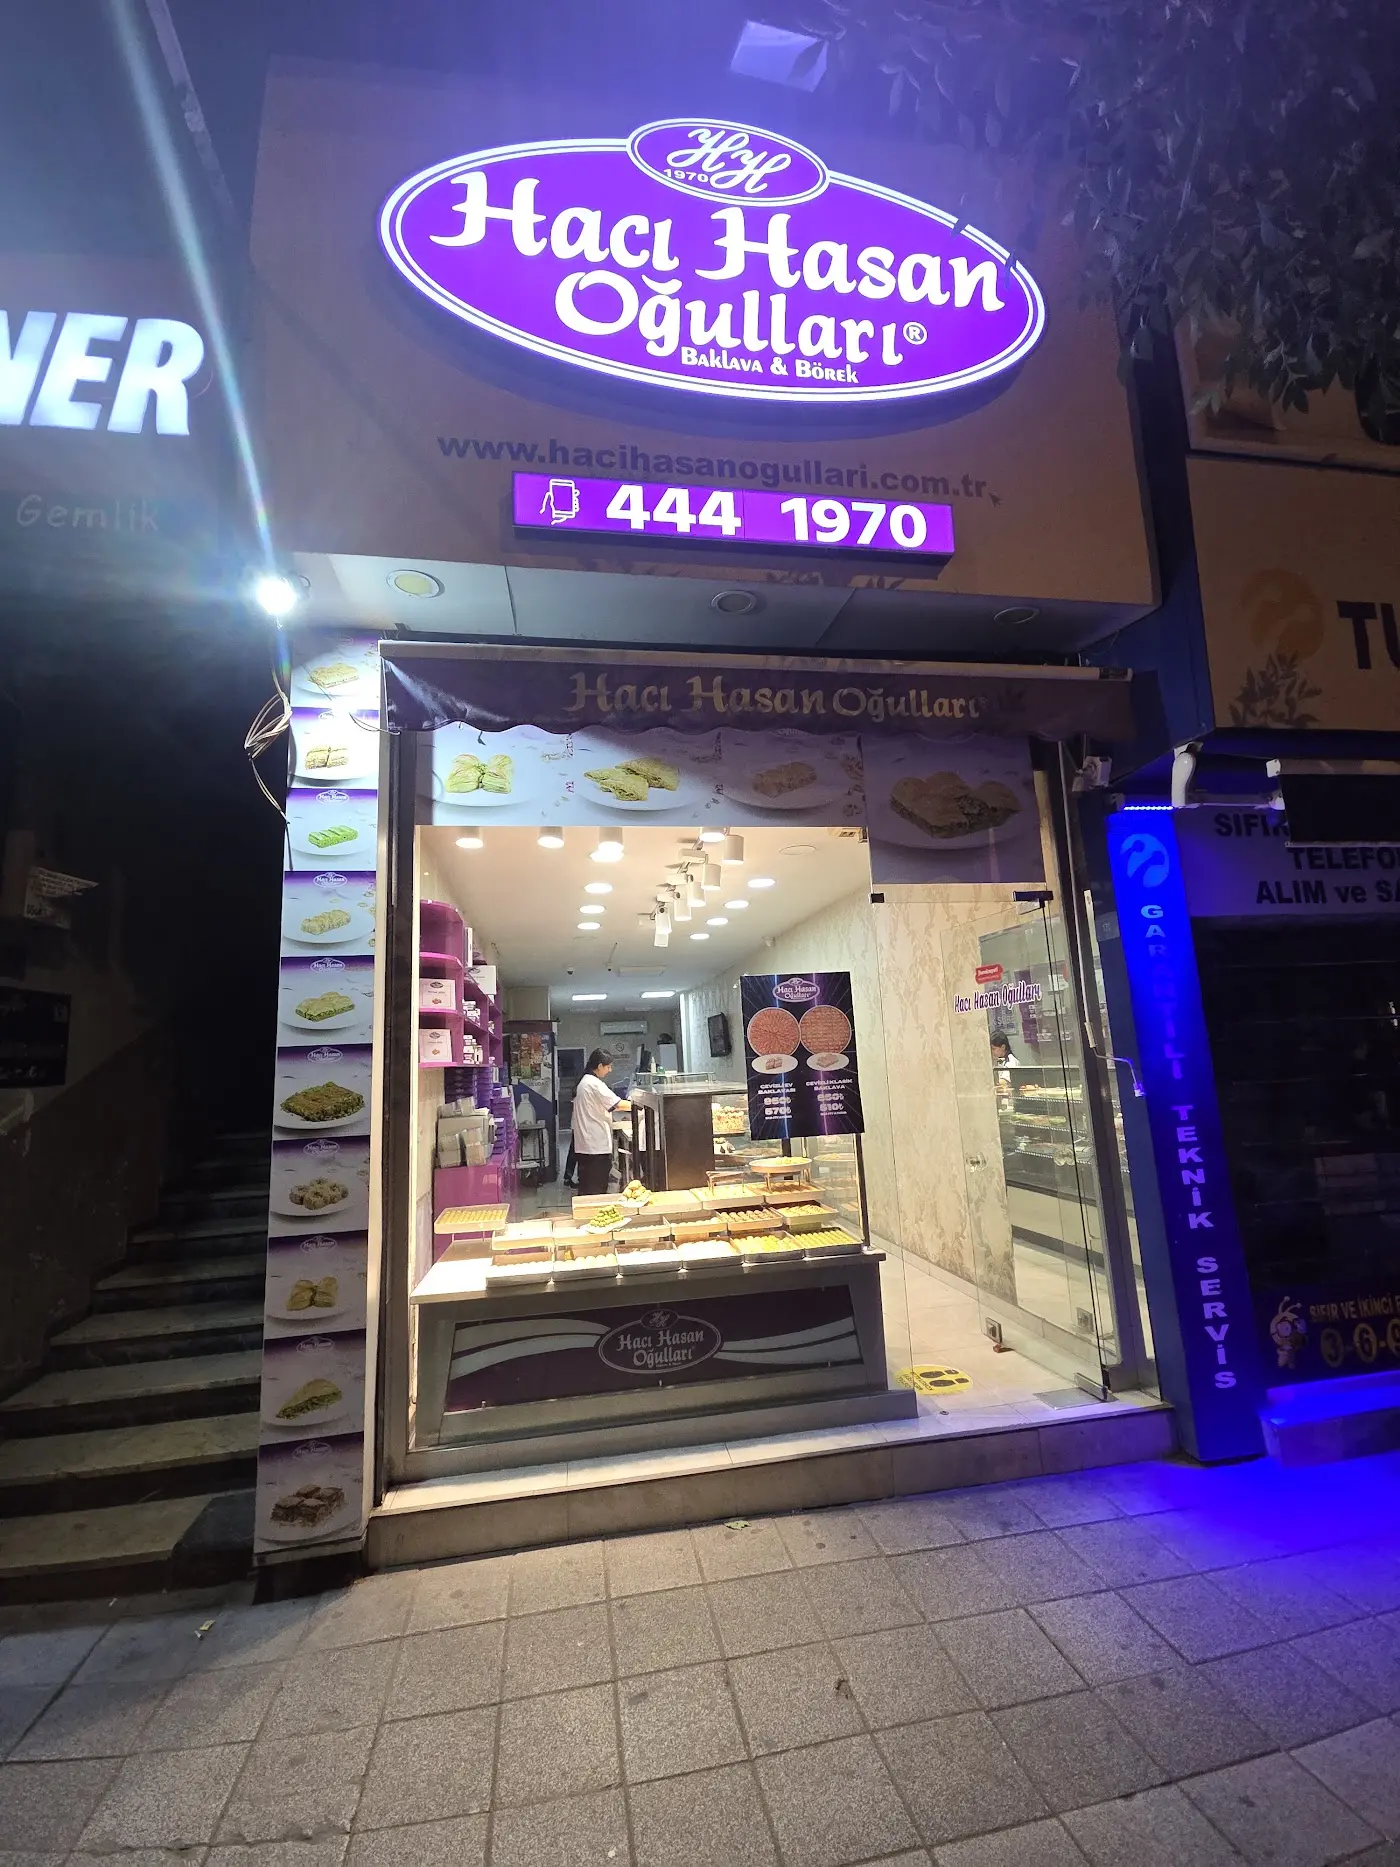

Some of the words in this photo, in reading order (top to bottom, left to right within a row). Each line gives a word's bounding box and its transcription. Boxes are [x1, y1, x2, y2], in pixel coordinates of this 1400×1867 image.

[663, 168, 709, 182] 1970
[429, 170, 680, 271] Hacı
[694, 206, 1005, 312] Hasan
[770, 356, 788, 376] &
[437, 435, 987, 500] www.hacihasanogullari.com.tr
[16, 492, 160, 532] Gemlik
[606, 483, 742, 537] 444
[779, 496, 928, 549] 1970
[561, 671, 673, 713] Hacı
[680, 675, 827, 715] Hasan
[1286, 847, 1400, 870] TELEFO
[1256, 879, 1327, 904] ALIM
[1334, 885, 1367, 903] ve
[1375, 879, 1400, 903] S
[973, 990, 1000, 1010] Hasan
[1170, 1104, 1214, 1230] TEKNİK
[1195, 1256, 1238, 1390] SERVİS
[1340, 1300, 1357, 1319] VE
[616, 1333, 652, 1352] Hacı
[654, 1329, 704, 1347] Hasan
